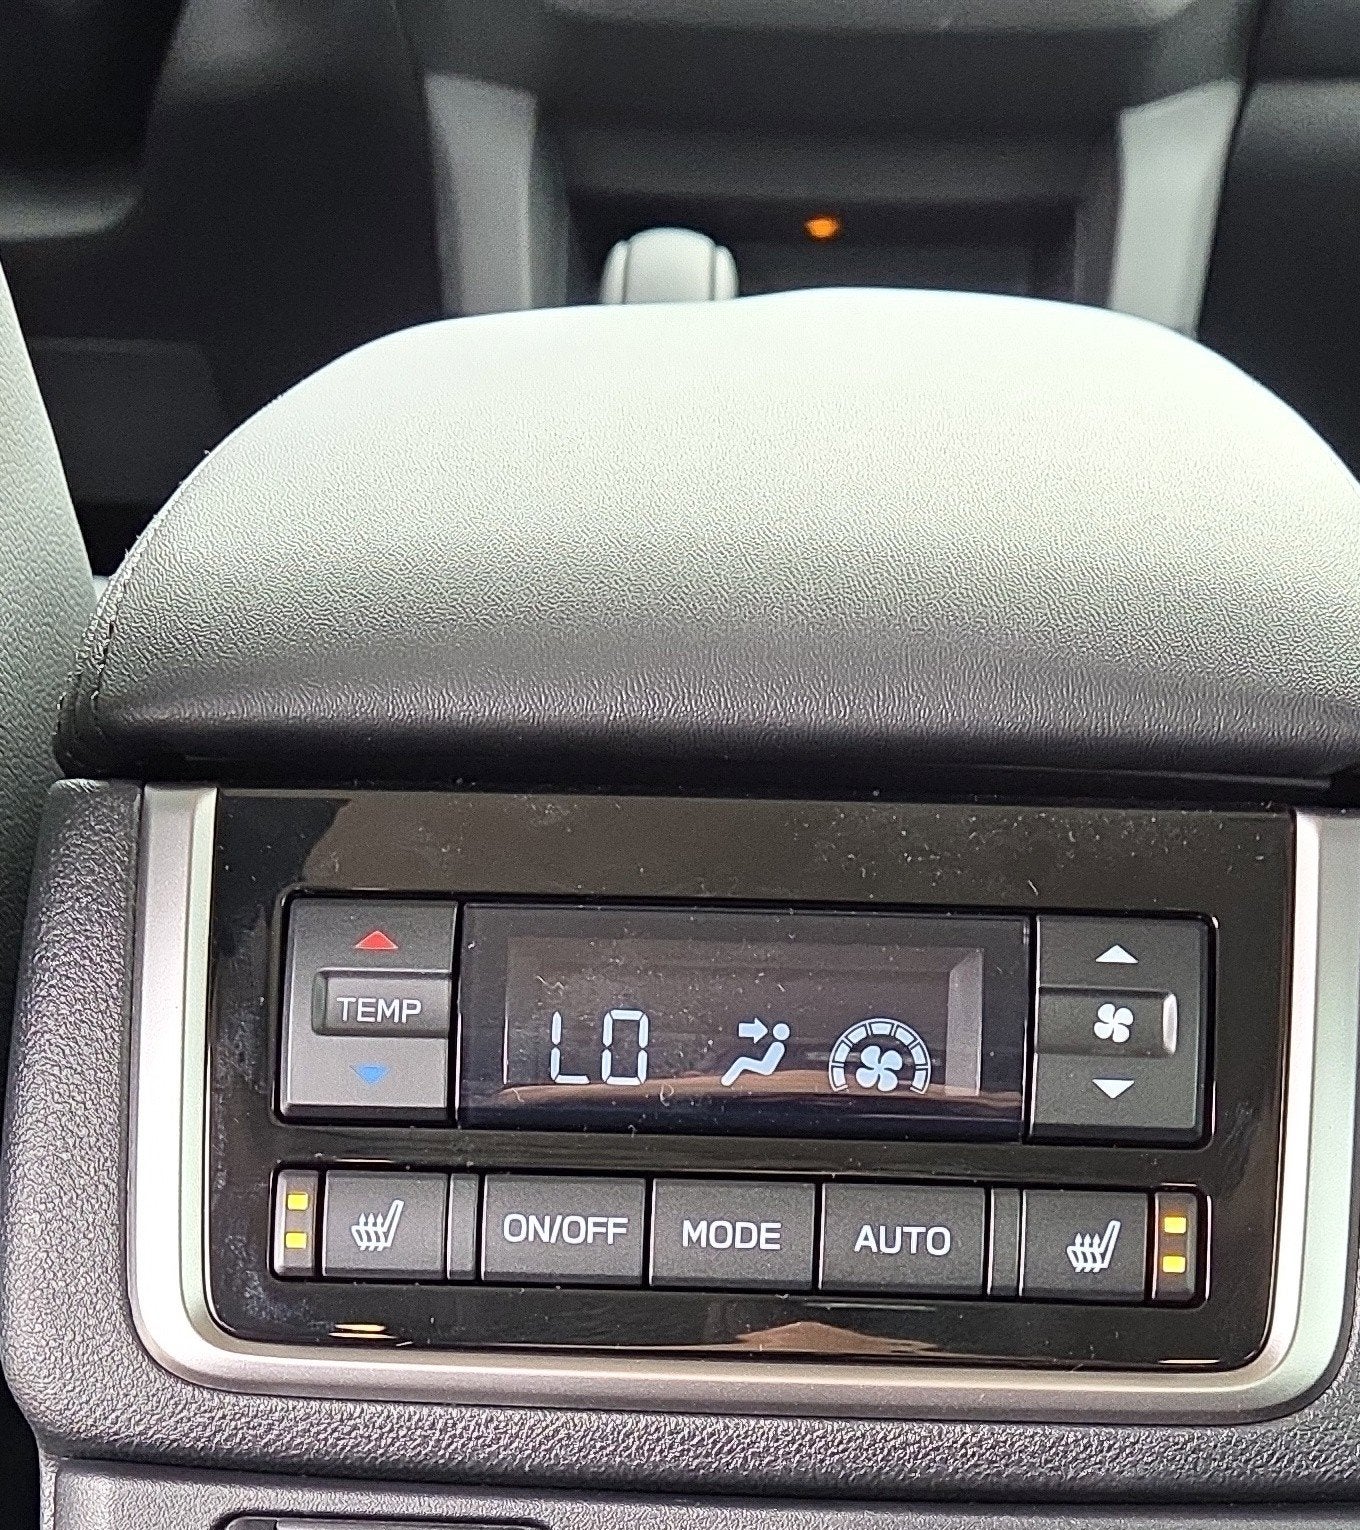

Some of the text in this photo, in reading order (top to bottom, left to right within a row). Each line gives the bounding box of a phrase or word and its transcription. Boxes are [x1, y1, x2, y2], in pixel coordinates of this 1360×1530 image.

[336, 996, 422, 1024] TEMP
[550, 1008, 650, 1086] LO
[502, 1213, 628, 1245] ON/OFF
[681, 1219, 782, 1250] MODE
[853, 1224, 951, 1256] AUTO
